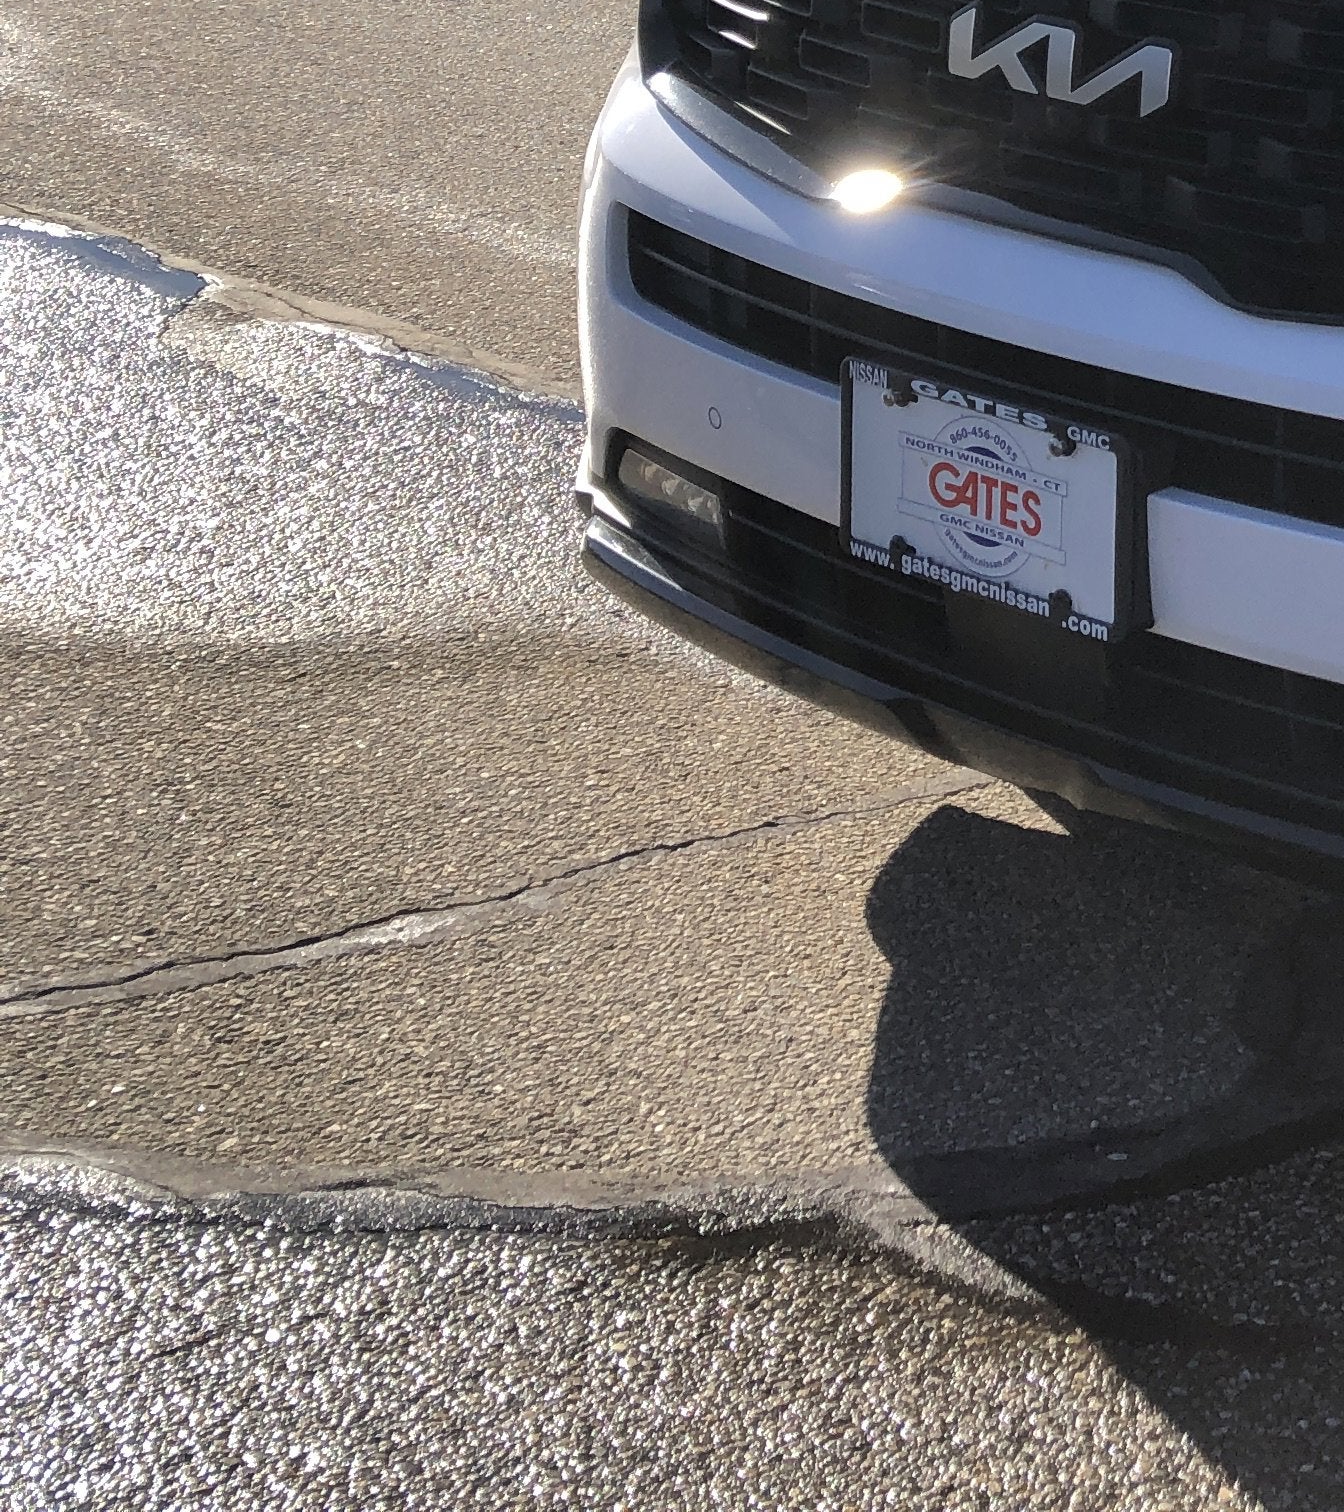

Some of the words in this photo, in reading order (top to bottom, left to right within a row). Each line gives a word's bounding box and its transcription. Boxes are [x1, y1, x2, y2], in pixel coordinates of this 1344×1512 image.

[946, 5, 1174, 119] KIA
[849, 360, 888, 389] NISSAN
[909, 378, 1049, 430] GATES
[948, 425, 1019, 463] 860-456-0055
[1066, 425, 1112, 451] GMC
[904, 436, 954, 458] NORTH
[957, 451, 1028, 482] WINDHAM
[1042, 479, 1062, 493] CT
[928, 461, 1042, 538] GATES
[939, 513, 973, 530] GMC
[974, 523, 1026, 548] NISSAN
